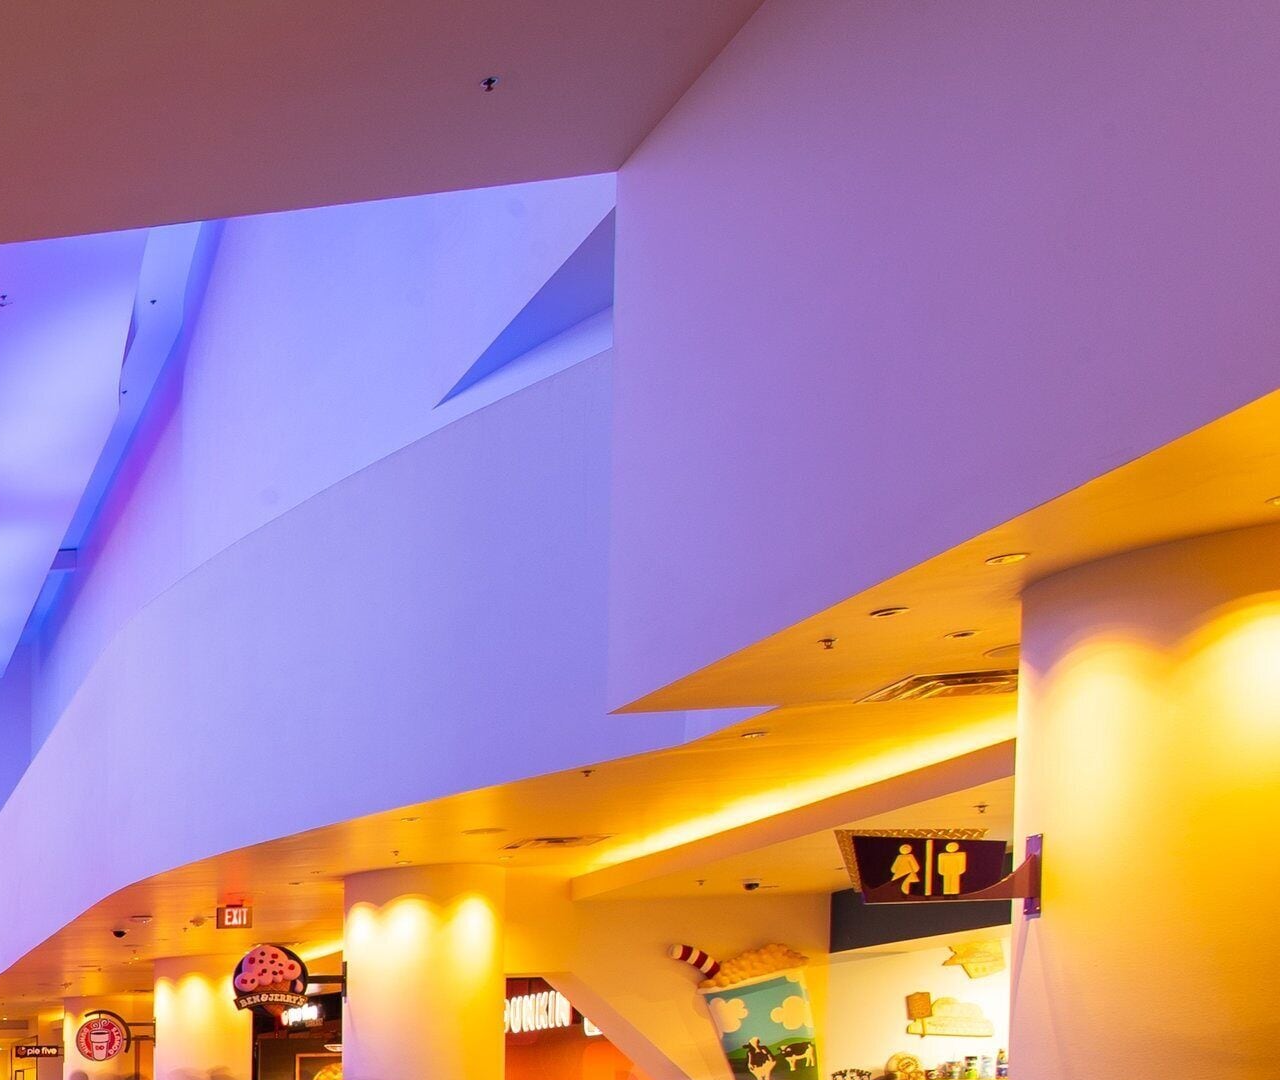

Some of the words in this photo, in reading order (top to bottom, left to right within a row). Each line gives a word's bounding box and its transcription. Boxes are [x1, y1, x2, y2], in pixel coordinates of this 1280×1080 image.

[224, 908, 248, 925] EXIT
[27, 1048, 40, 1056] pie
[41, 1047, 58, 1055] five
